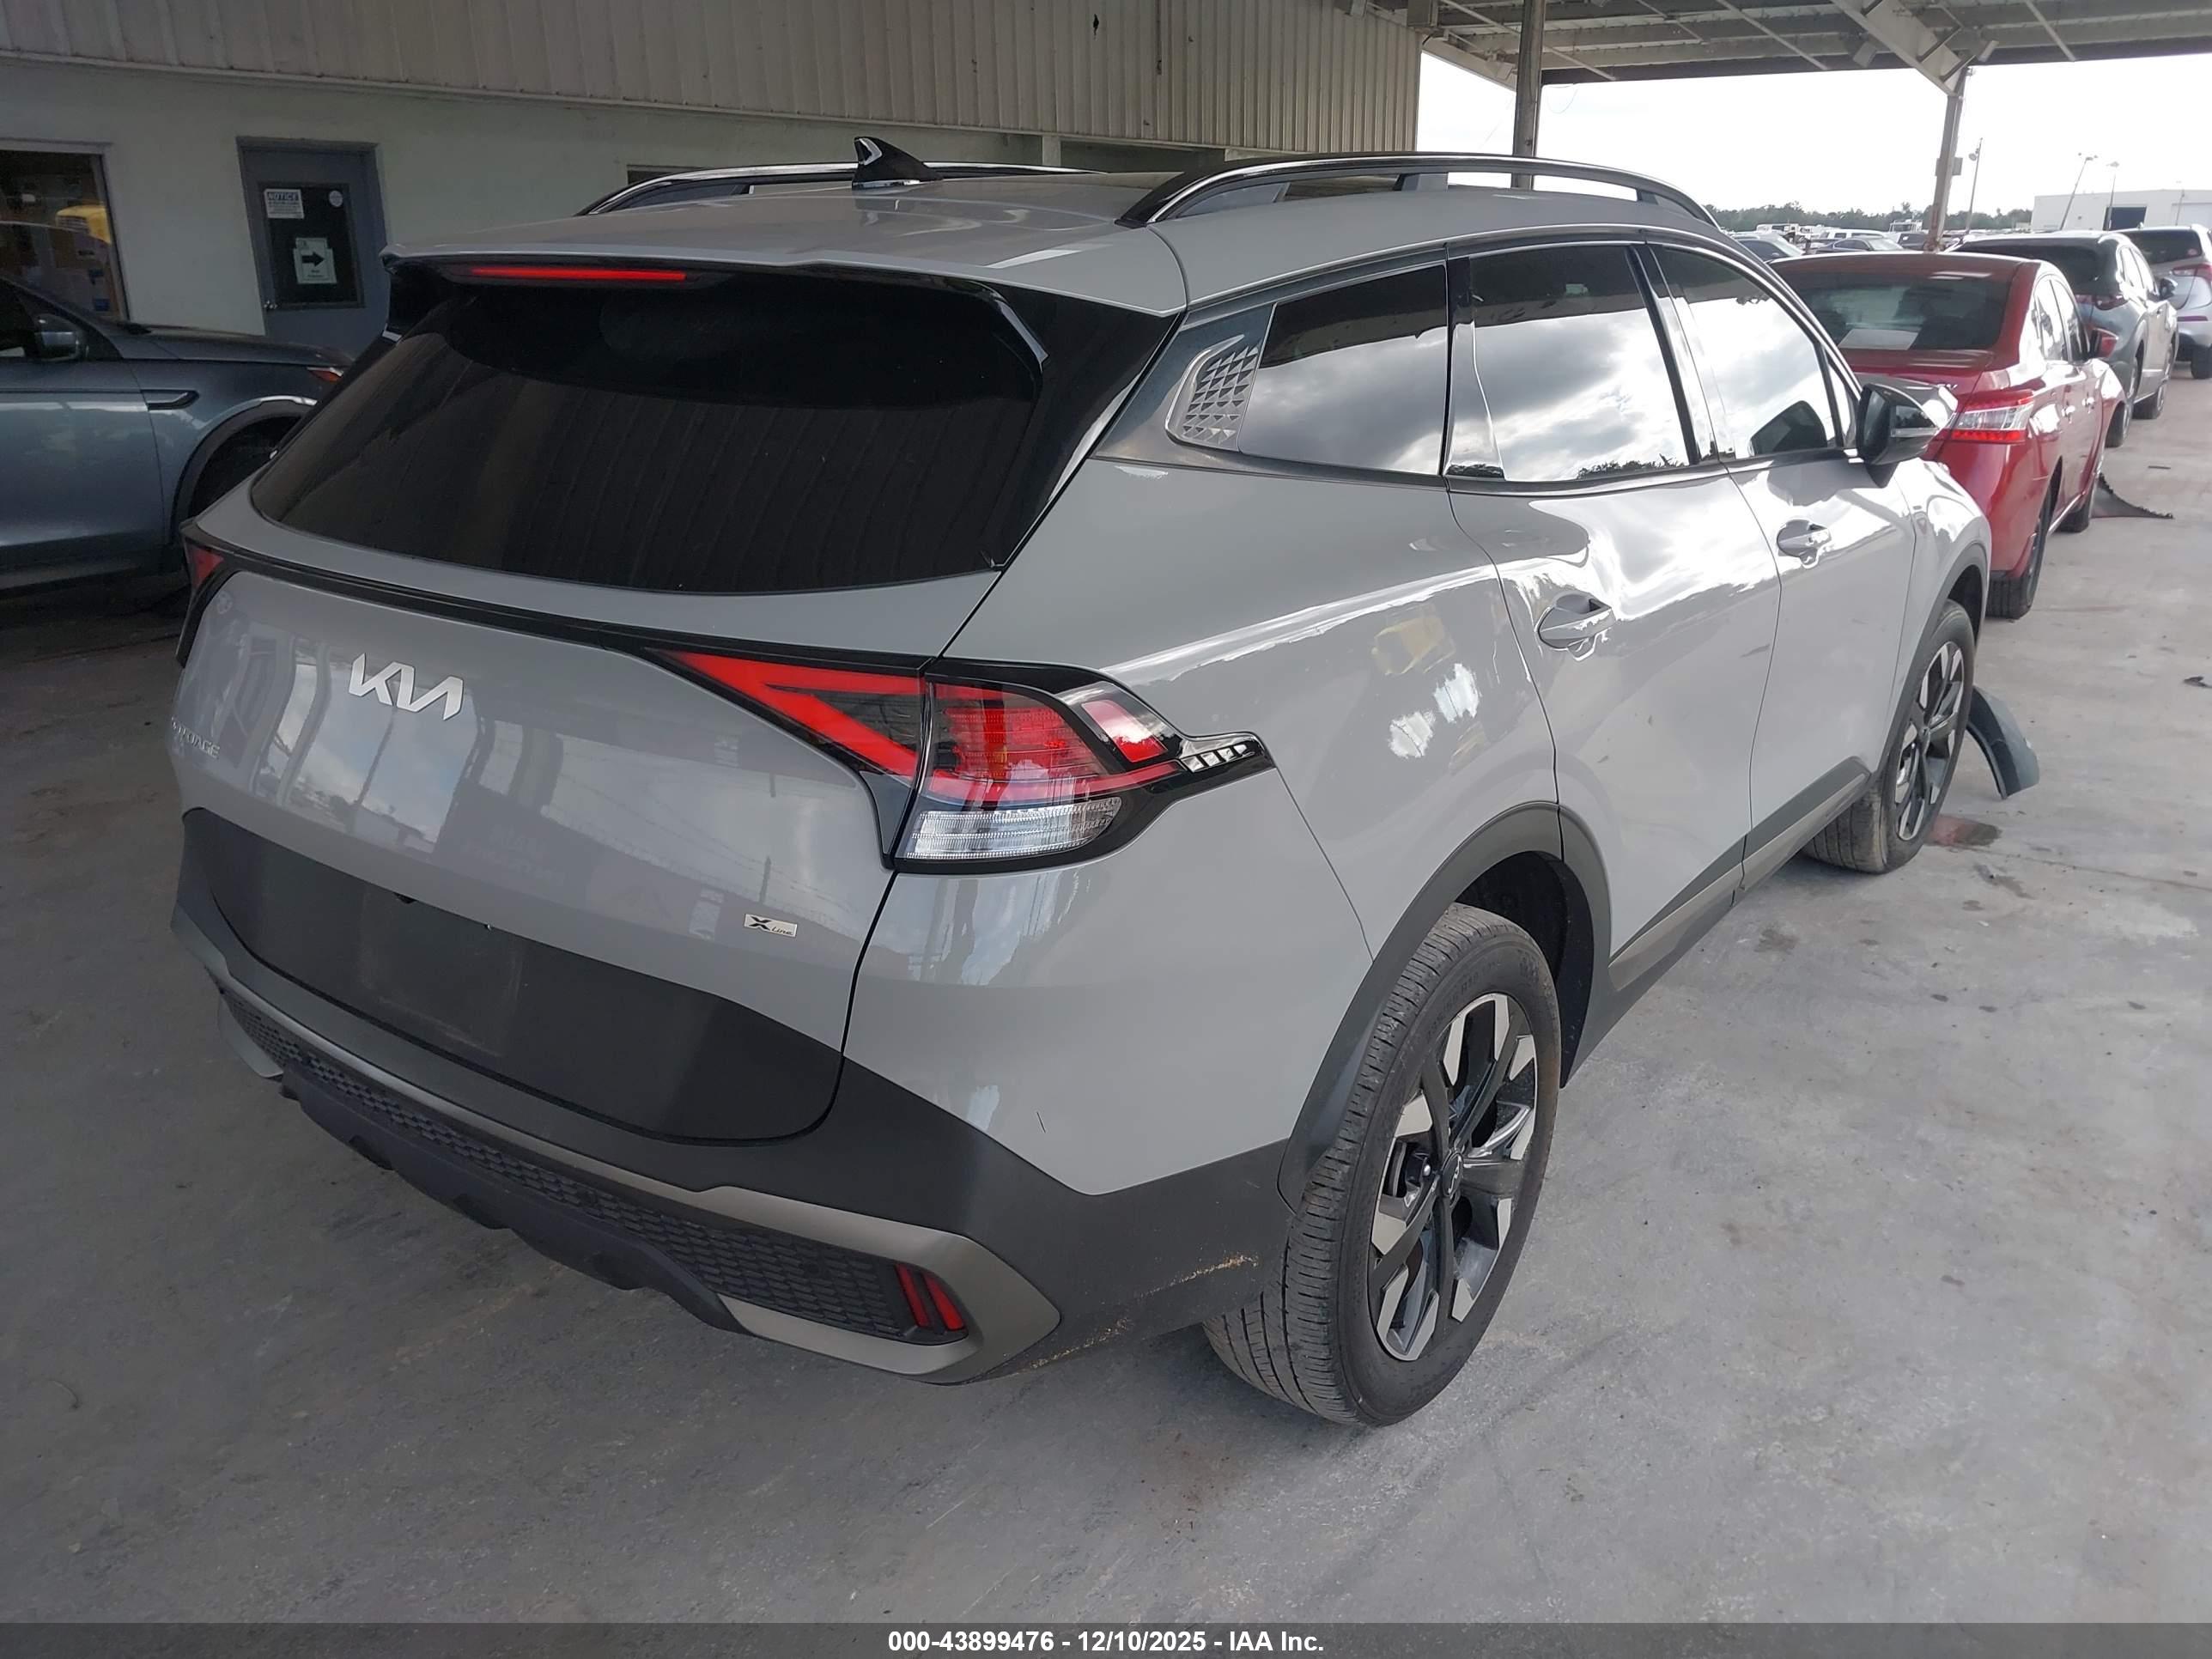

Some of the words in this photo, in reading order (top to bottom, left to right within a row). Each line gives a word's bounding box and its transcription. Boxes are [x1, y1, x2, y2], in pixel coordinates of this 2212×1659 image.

[267, 192, 299, 201] NOTICE
[348, 653, 465, 721] KIA
[748, 915, 773, 932] X
